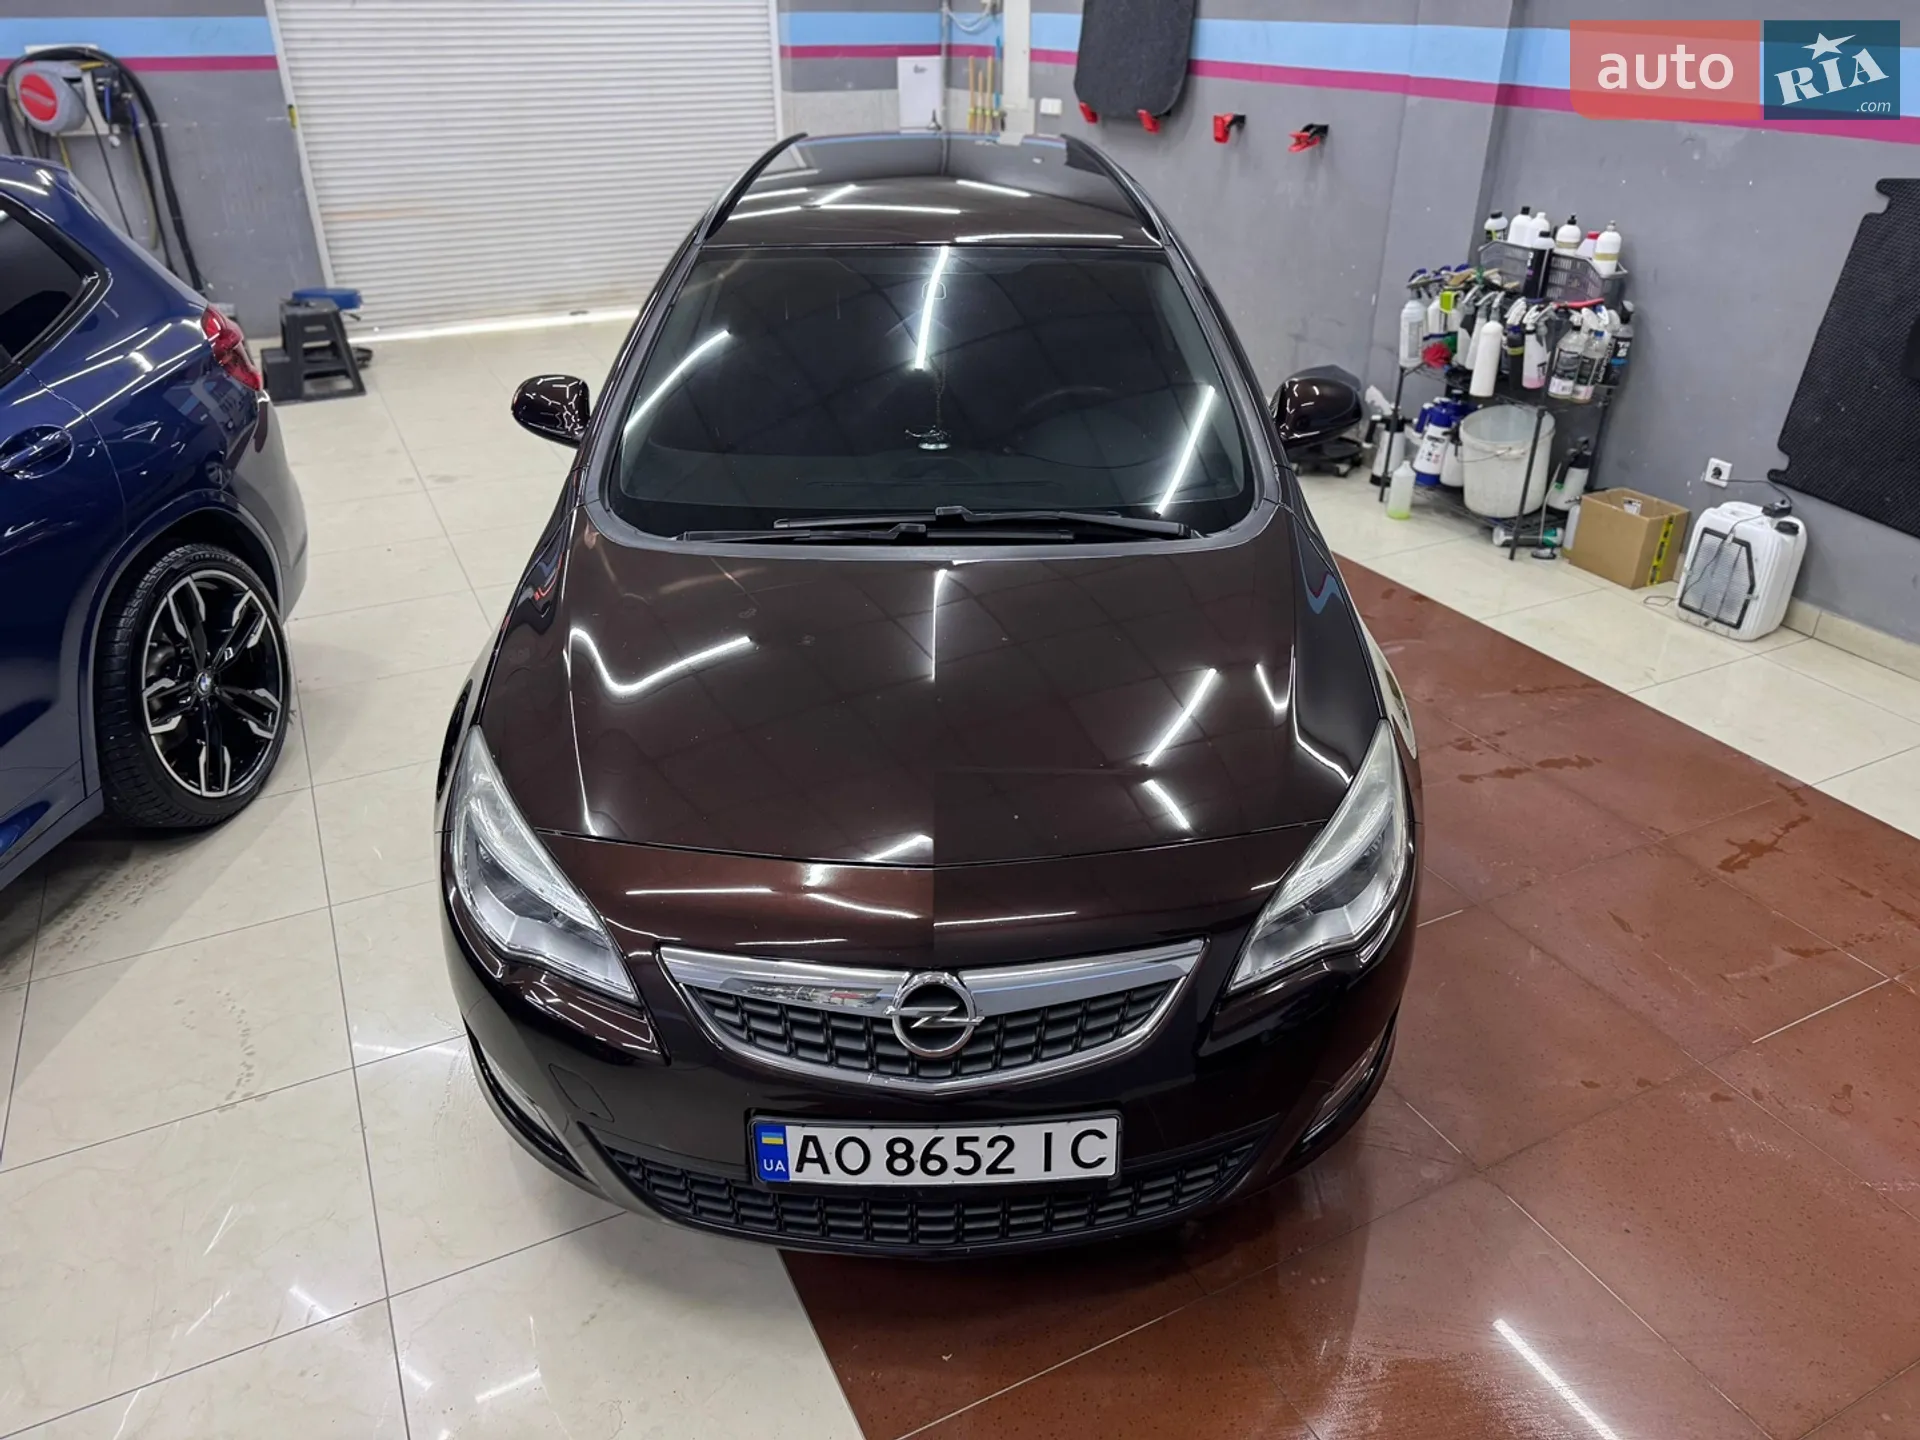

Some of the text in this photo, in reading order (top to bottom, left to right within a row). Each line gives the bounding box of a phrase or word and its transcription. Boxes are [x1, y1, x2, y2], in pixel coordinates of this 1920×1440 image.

[763, 1159, 786, 1172] UA
[794, 1134, 872, 1176] AO
[885, 1135, 1016, 1177] 8652
